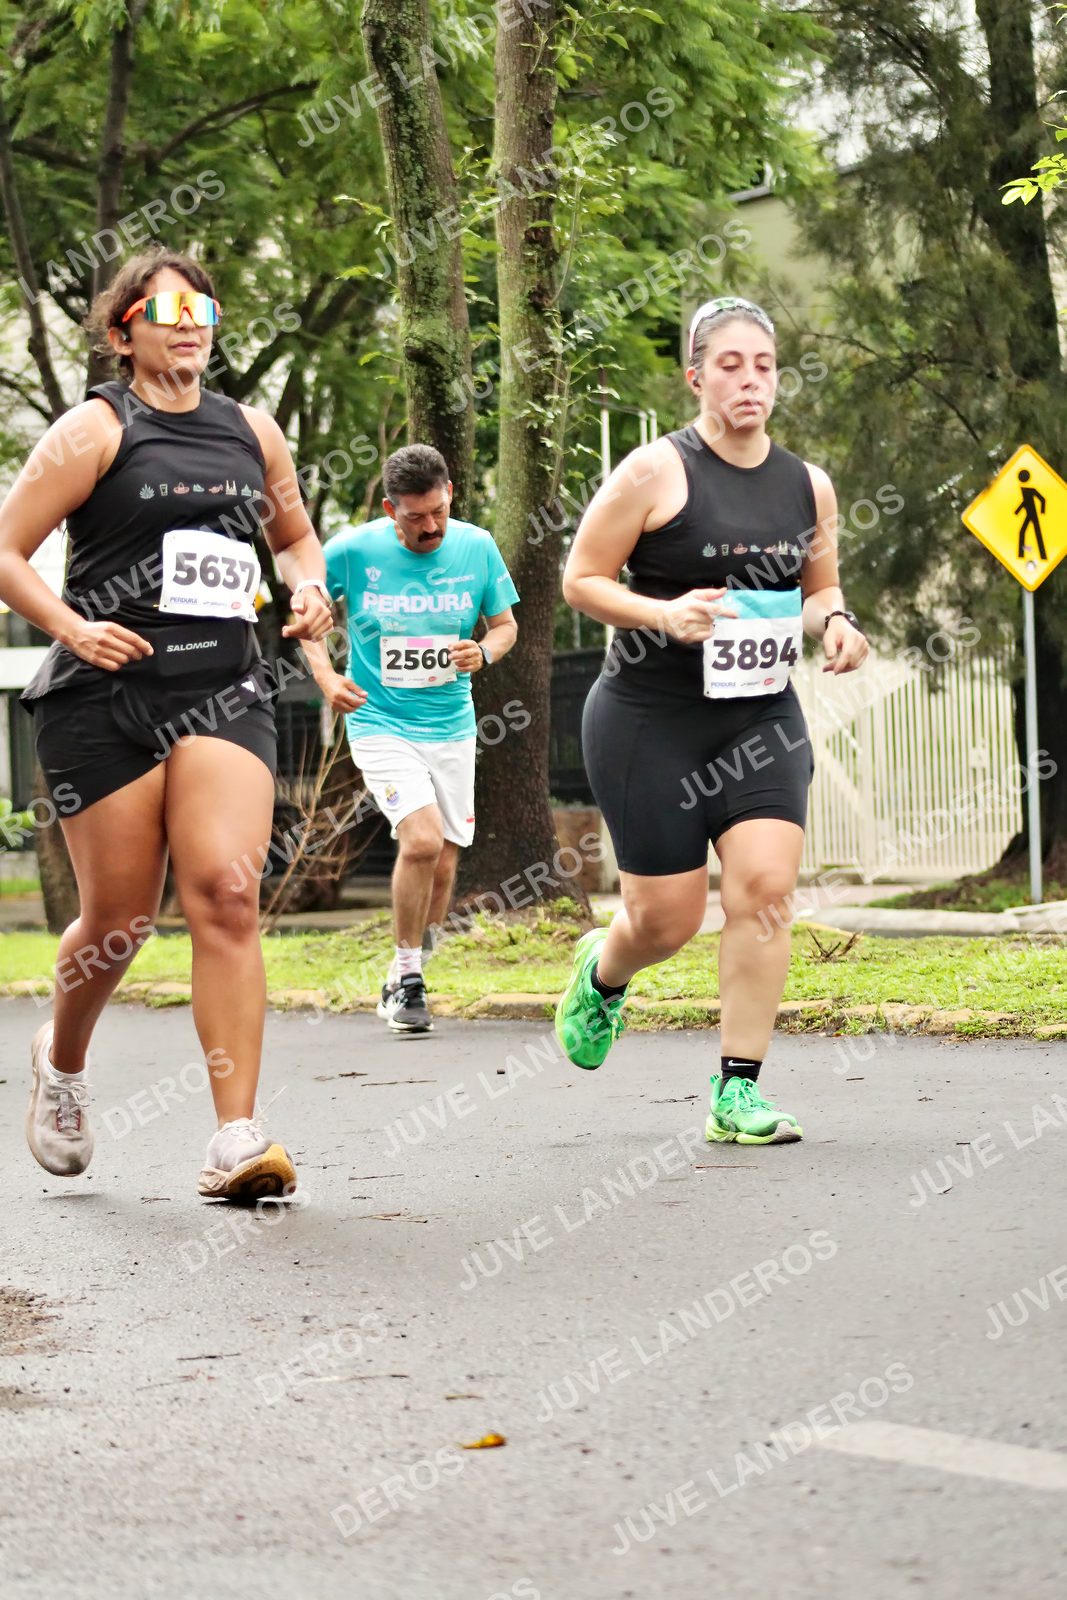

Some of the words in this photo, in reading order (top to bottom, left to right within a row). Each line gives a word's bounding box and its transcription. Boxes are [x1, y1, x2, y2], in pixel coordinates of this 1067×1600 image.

[173, 552, 255, 593] 5637
[363, 591, 474, 613] PERDURA
[166, 640, 218, 652] SALOMON
[712, 636, 798, 670] 3894
[386, 648, 452, 670] 2560
